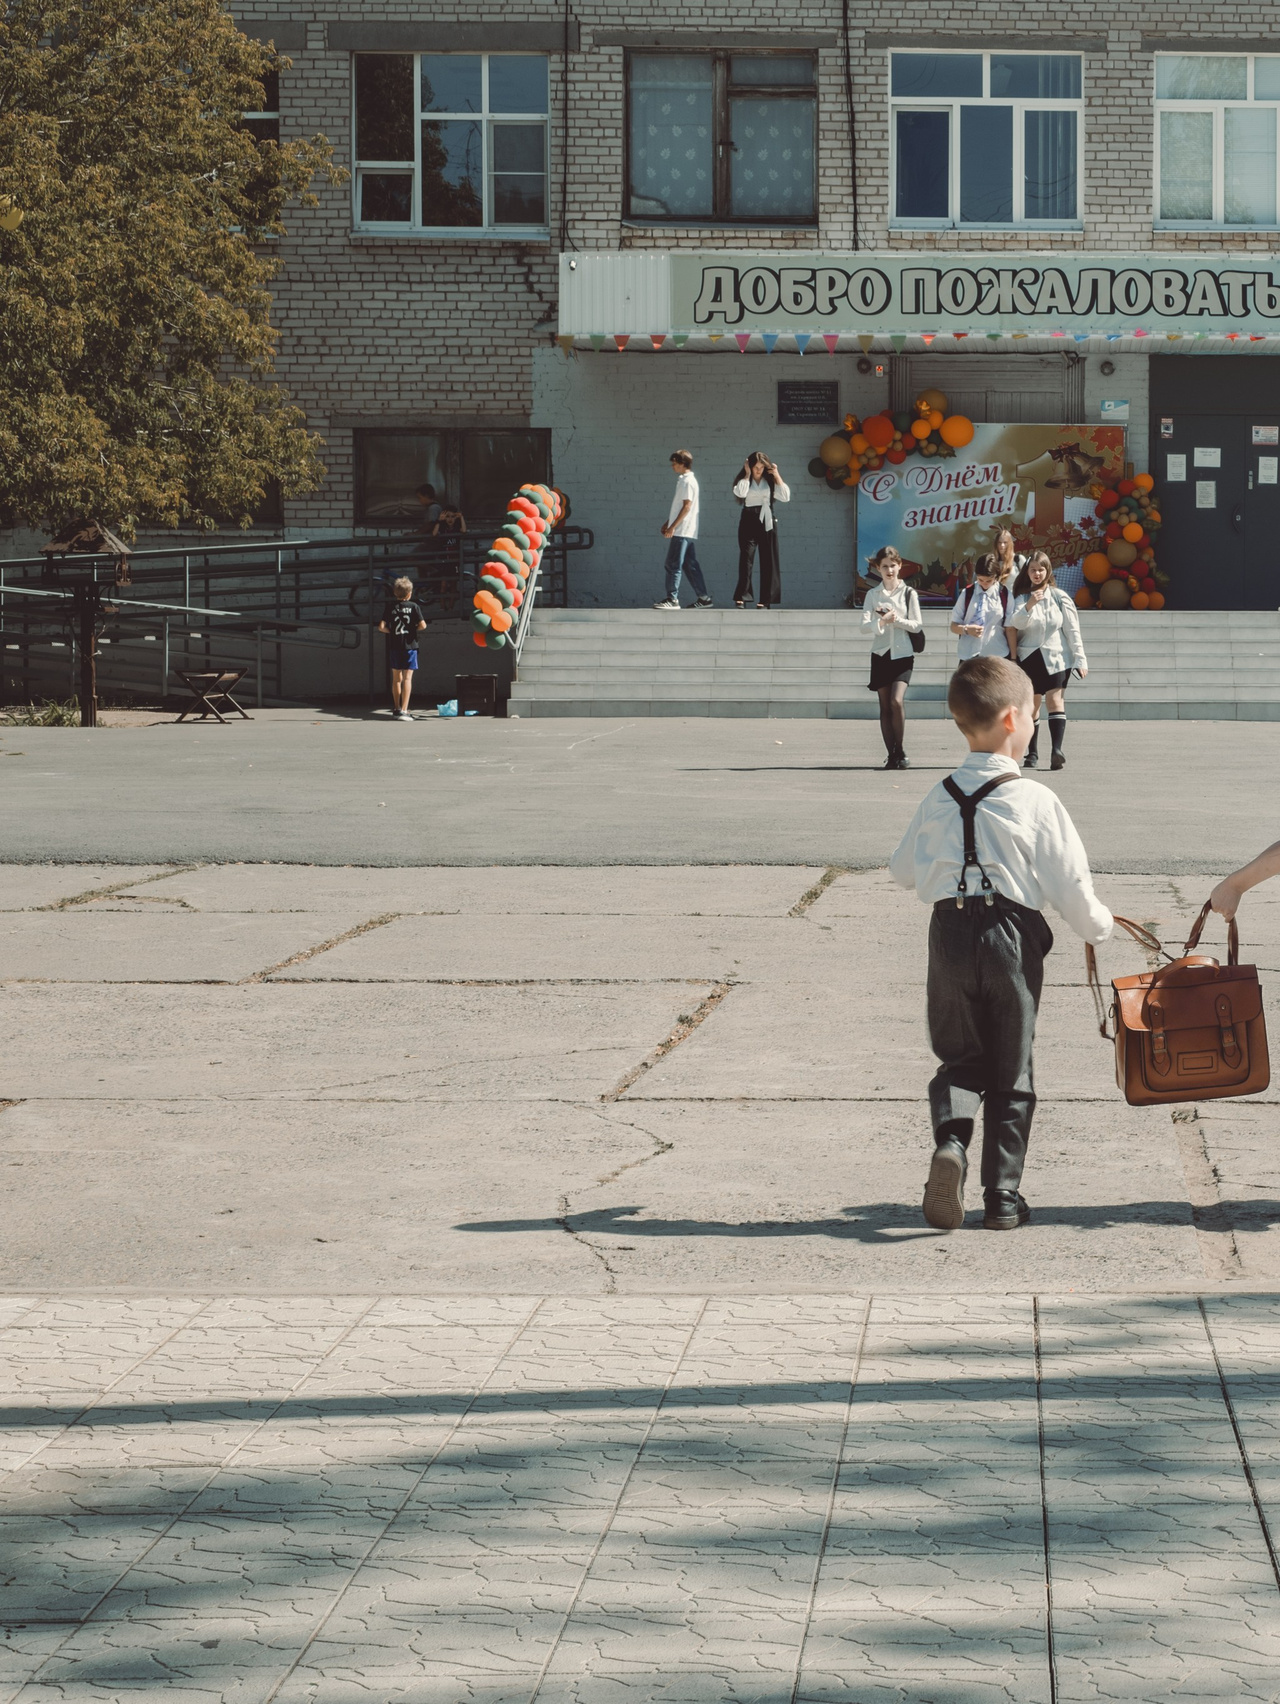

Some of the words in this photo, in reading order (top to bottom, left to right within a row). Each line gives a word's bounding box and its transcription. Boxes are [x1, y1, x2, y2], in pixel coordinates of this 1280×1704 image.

[694, 266, 892, 323] ДОБРО
[859, 472, 895, 501] С
[905, 464, 1001, 495] Днём
[904, 485, 1017, 528] знаний!
